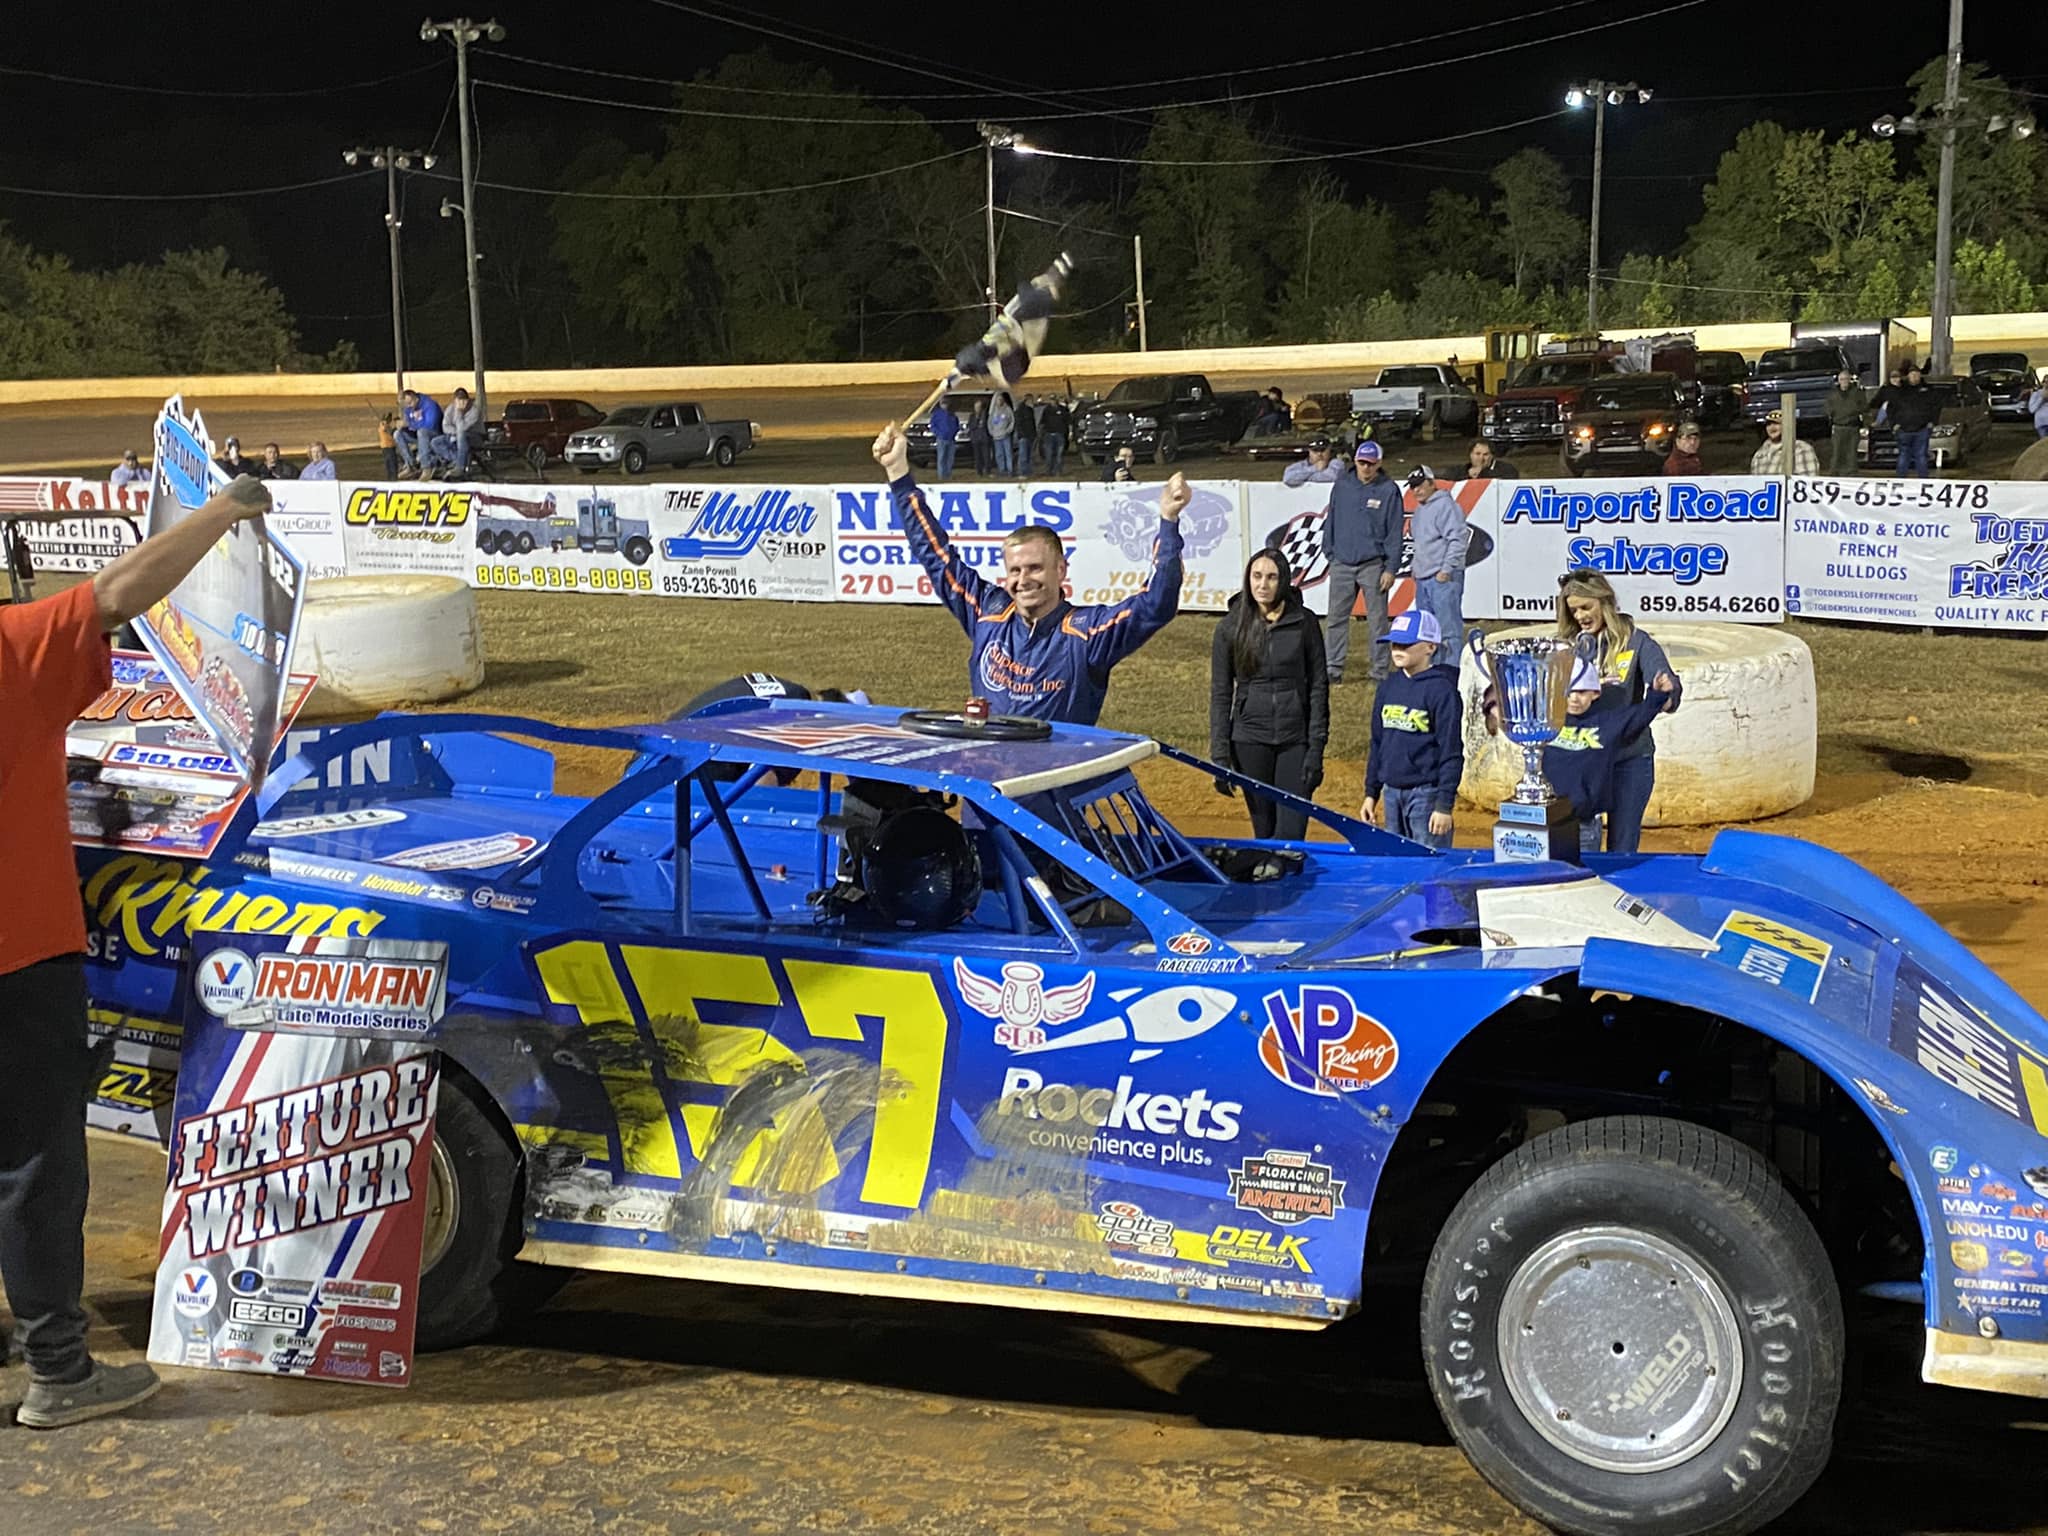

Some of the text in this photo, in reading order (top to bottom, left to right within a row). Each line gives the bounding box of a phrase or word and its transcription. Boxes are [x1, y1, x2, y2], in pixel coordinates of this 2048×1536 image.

[344, 487, 474, 525] CAREY'S
[1792, 480, 1989, 508] 859-655-5478
[665, 490, 819, 538] THE Muffler
[837, 491, 1074, 531] NALS
[1502, 482, 1781, 533] Airport Road
[1793, 519, 1951, 538] STANDARD & EXOTIC
[1566, 537, 1729, 585] Salvage
[1839, 543, 1898, 558] FRENCH
[475, 565, 653, 590] 866-839-8895
[705, 566, 737, 576] Powell
[1826, 563, 1908, 580] BULLDOGS
[1640, 596, 1780, 613] 859.854.6260
[1935, 606, 2000, 622] QUALITY
[2005, 609, 2035, 622] AKC
[84, 855, 386, 955] Rivers
[203, 984, 246, 1001] VALVOLINE
[256, 960, 433, 1007] IRON MAN
[314, 1009, 368, 1027] Model
[371, 1013, 429, 1031] Series
[1262, 984, 1357, 1092] VP
[1325, 1041, 1395, 1075] Racing
[997, 1067, 1243, 1141] Rockets
[176, 1055, 429, 1188] FEATURE
[1029, 1127, 1156, 1159] convenience
[1258, 1166, 1325, 1184] FLORACING
[1260, 1179, 1312, 1194] NIGHT IN
[186, 1136, 414, 1257] WINNER
[1239, 1188, 1331, 1215] AMERICA
[1098, 1213, 1173, 1236] gotta
[1946, 1220, 2029, 1241] UNOH.EDU
[1105, 1228, 1172, 1248] race
[1209, 1225, 1313, 1273] DELK
[1214, 1247, 1289, 1265] EQUIPMENT
[1954, 1278, 2017, 1292] GENERAL
